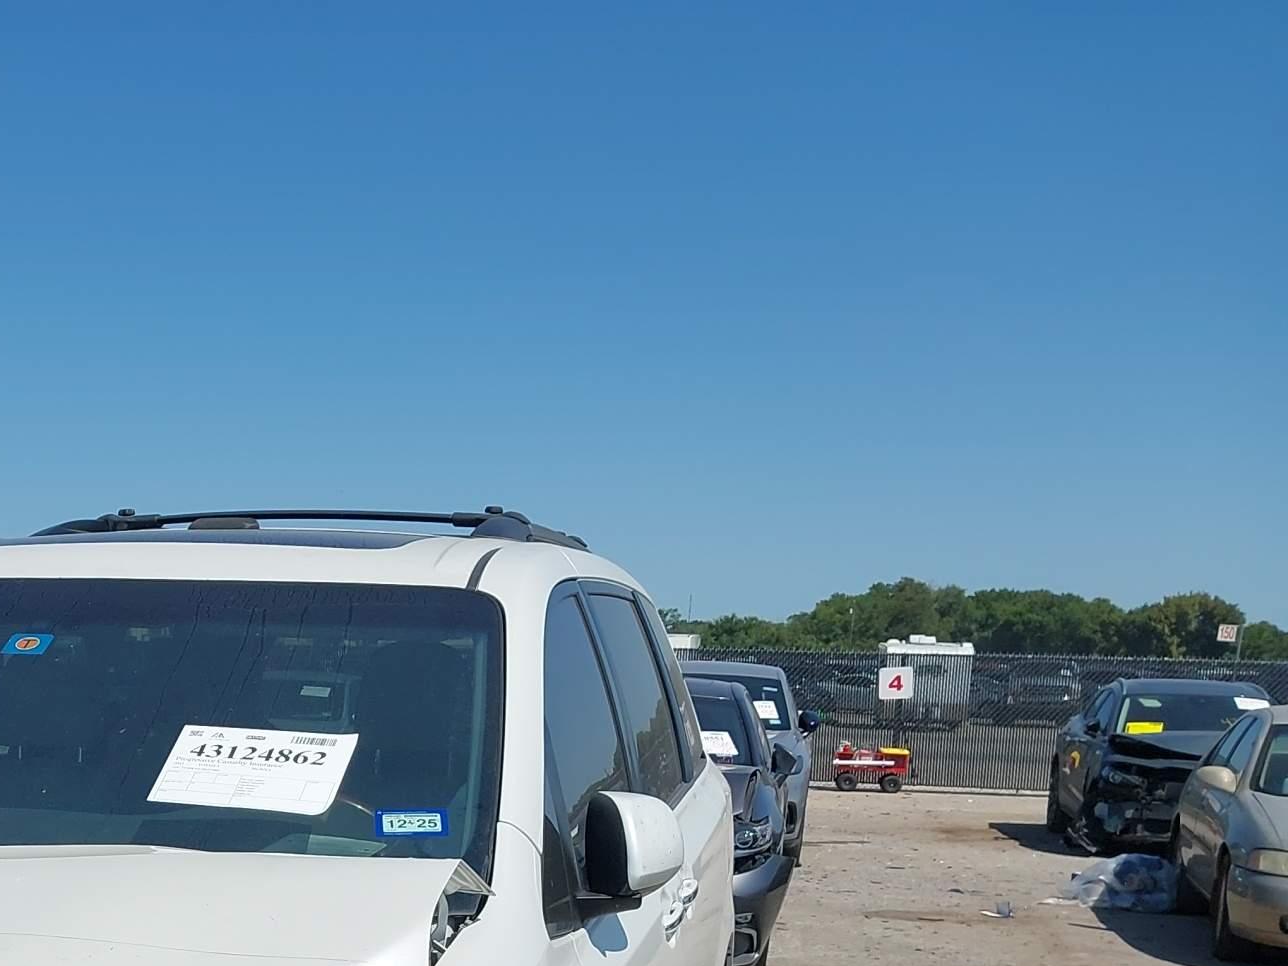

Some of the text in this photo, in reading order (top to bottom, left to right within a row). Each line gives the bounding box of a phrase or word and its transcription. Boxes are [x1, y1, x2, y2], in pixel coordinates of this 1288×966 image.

[1220, 625, 1235, 640] 150
[888, 674, 904, 691] 4
[189, 743, 327, 766] 43124862
